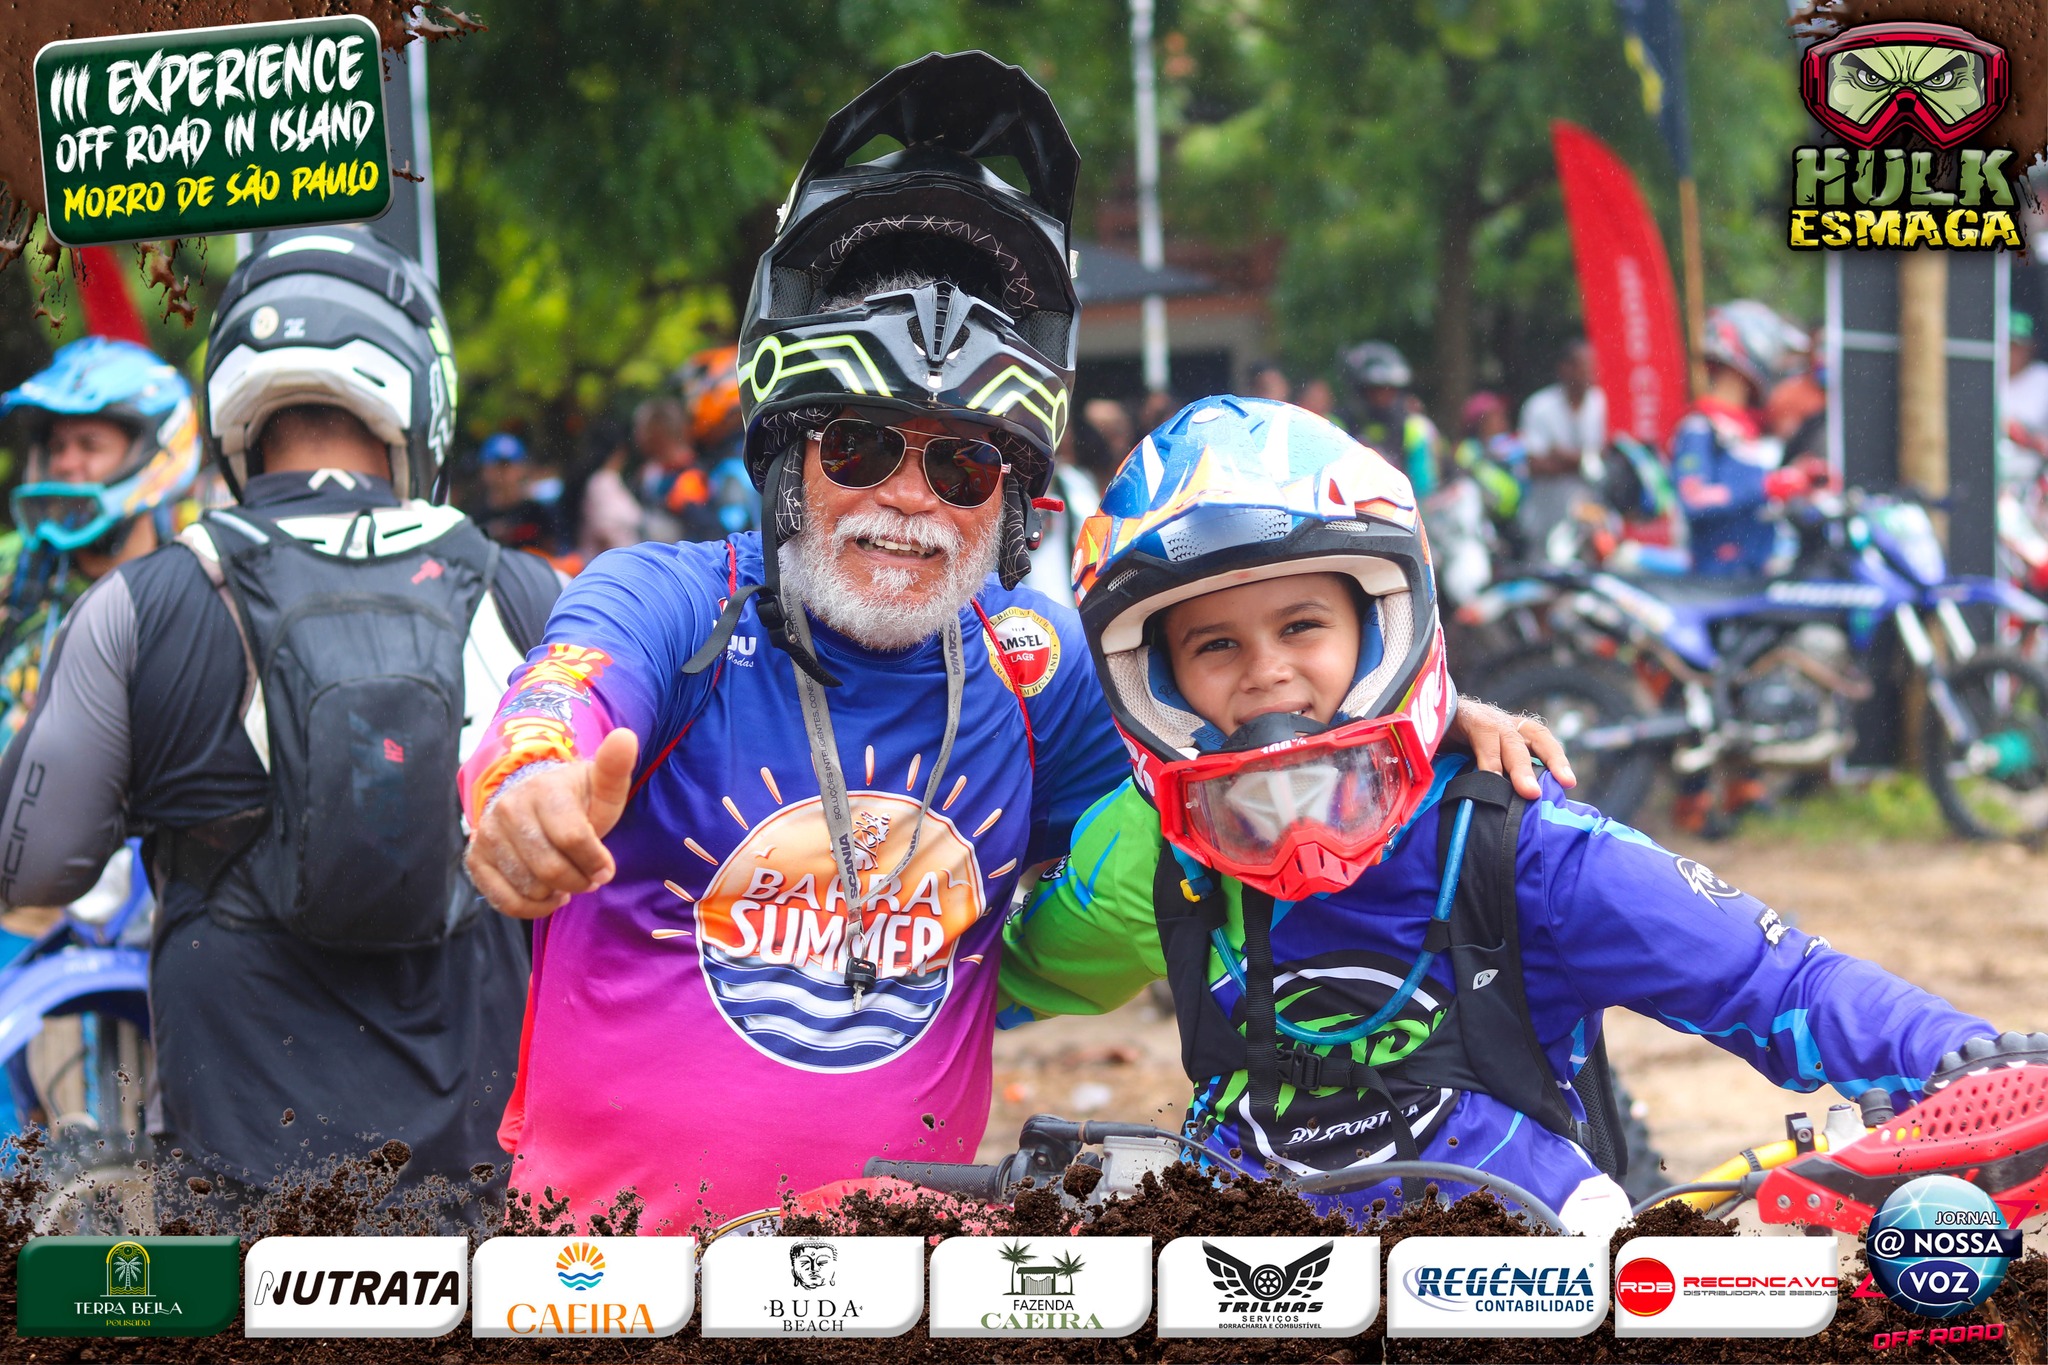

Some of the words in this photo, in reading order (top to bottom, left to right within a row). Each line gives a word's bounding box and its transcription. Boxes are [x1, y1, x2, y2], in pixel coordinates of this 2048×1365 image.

[1260, 737, 1307, 754] 100%
[839, 833, 858, 899] SCANIA
[1313, 1104, 1419, 1142] SPORTA
